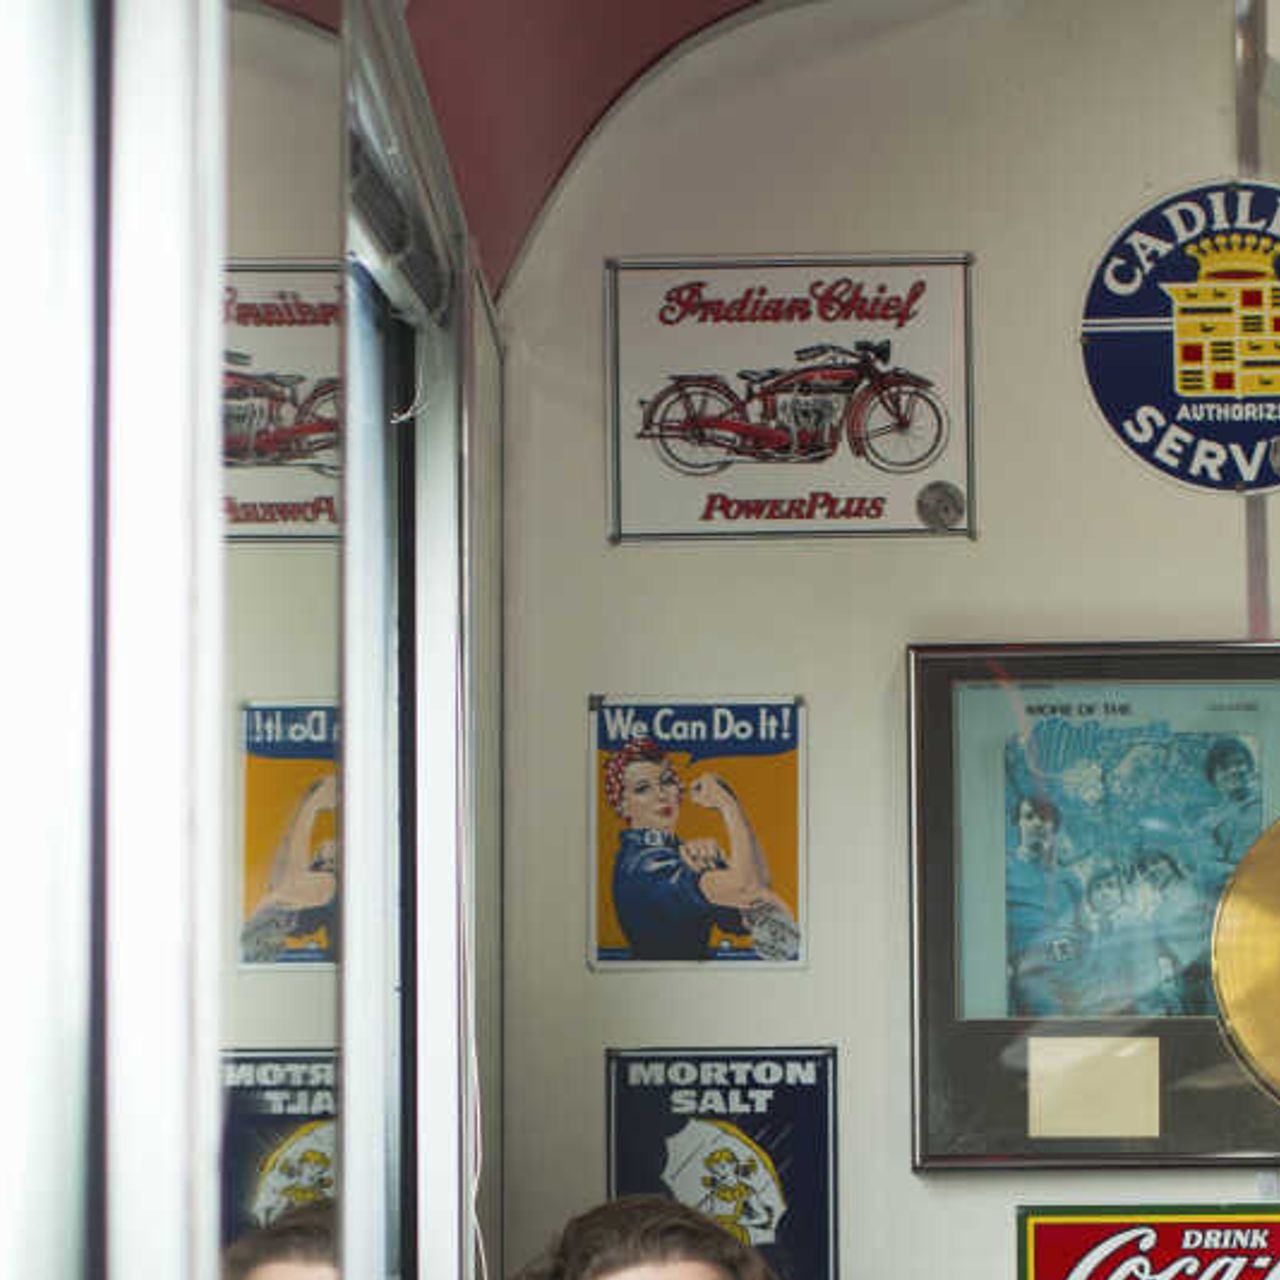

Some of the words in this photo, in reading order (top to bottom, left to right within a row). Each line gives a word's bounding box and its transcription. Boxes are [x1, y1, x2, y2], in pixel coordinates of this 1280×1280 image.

[658, 281, 813, 326] Indian
[810, 278, 927, 328] Chief
[603, 707, 648, 740] We
[653, 707, 707, 740] Can
[713, 707, 753, 740] Do
[758, 706, 792, 740] It!
[627, 1062, 817, 1086] MORTON
[670, 1089, 775, 1114] SALT
[1181, 1228, 1269, 1250] DRINK
